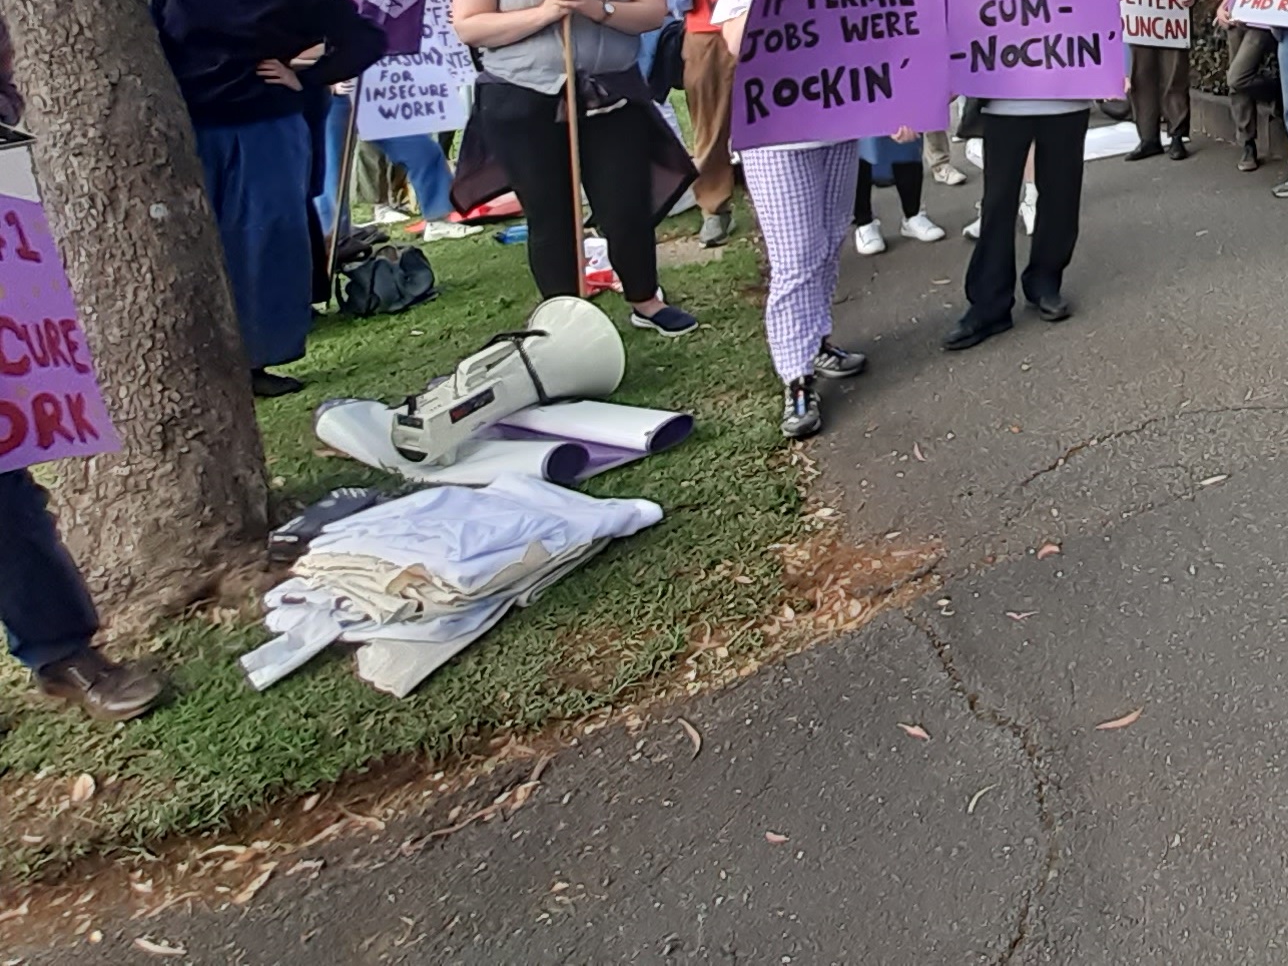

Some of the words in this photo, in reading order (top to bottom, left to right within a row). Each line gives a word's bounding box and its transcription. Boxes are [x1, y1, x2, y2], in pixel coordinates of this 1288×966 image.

[739, 19, 820, 63] JOBS
[840, 10, 920, 43] WERE
[1121, 14, 1188, 40] UNCAN
[380, 69, 414, 83] FOR
[365, 83, 449, 102] INSECURE
[378, 100, 446, 121] WORK!
